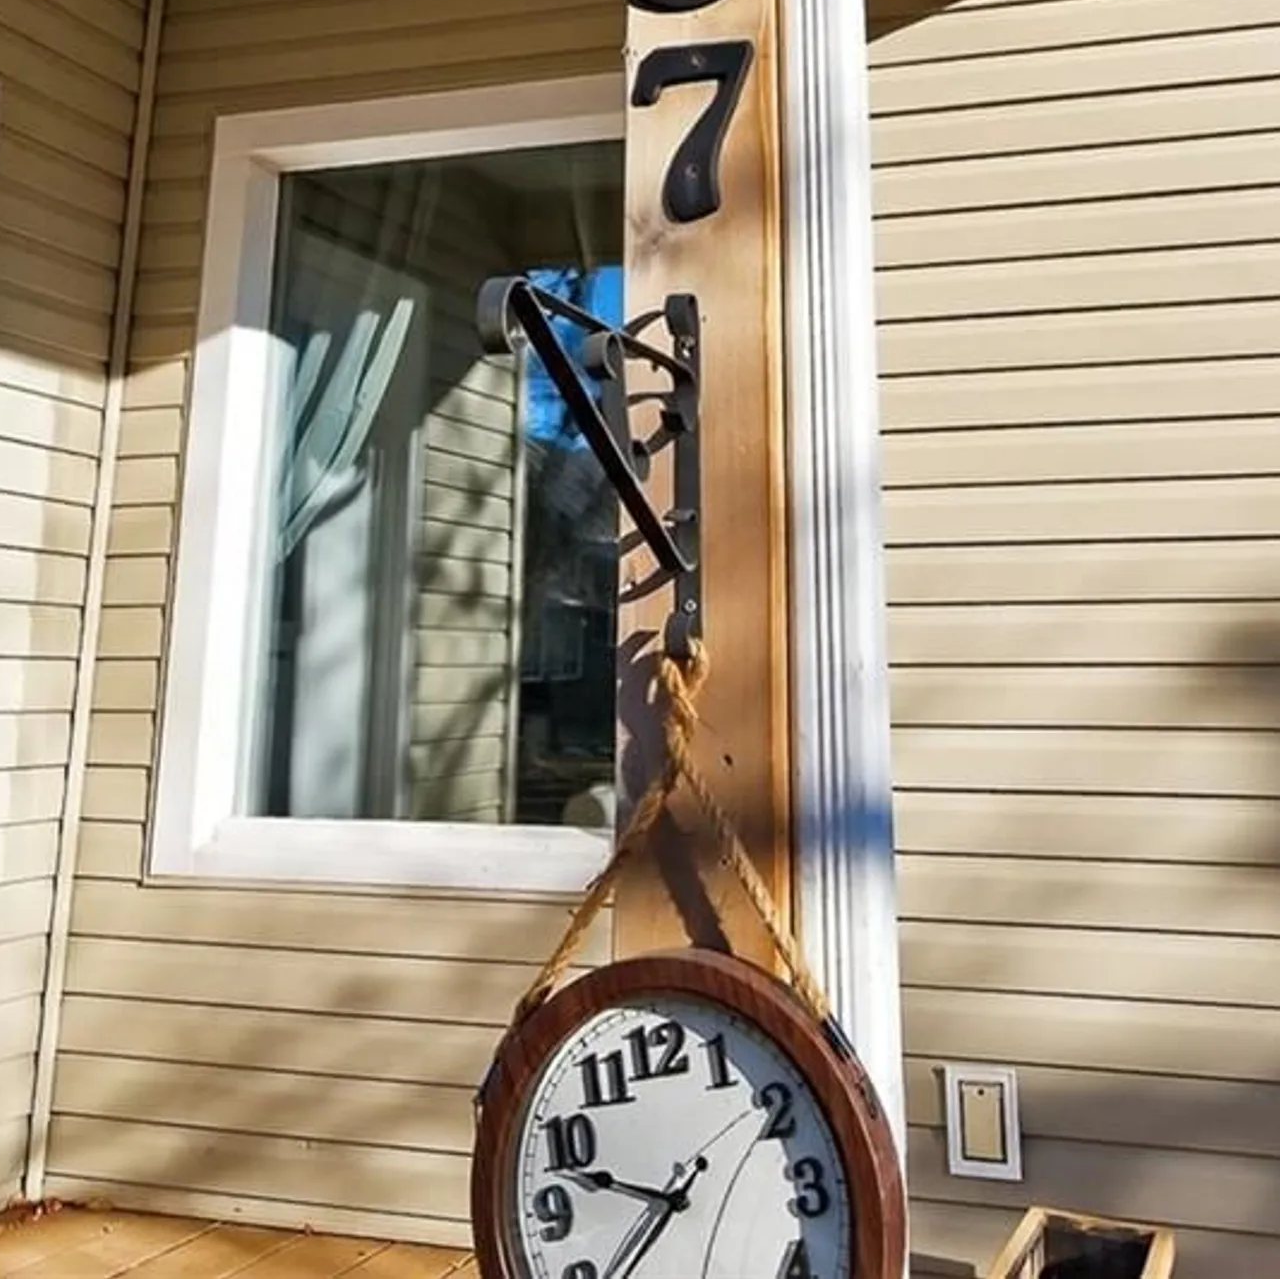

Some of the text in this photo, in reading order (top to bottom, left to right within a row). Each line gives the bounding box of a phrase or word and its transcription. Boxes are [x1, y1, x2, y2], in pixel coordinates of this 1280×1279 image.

[574, 1050, 635, 1108] 11
[622, 1020, 690, 1081] 12
[699, 1033, 738, 1090] 1
[755, 1082, 796, 1140] 2
[540, 1113, 596, 1172] 10
[533, 1184, 574, 1243] 9
[790, 1157, 830, 1218] 3
